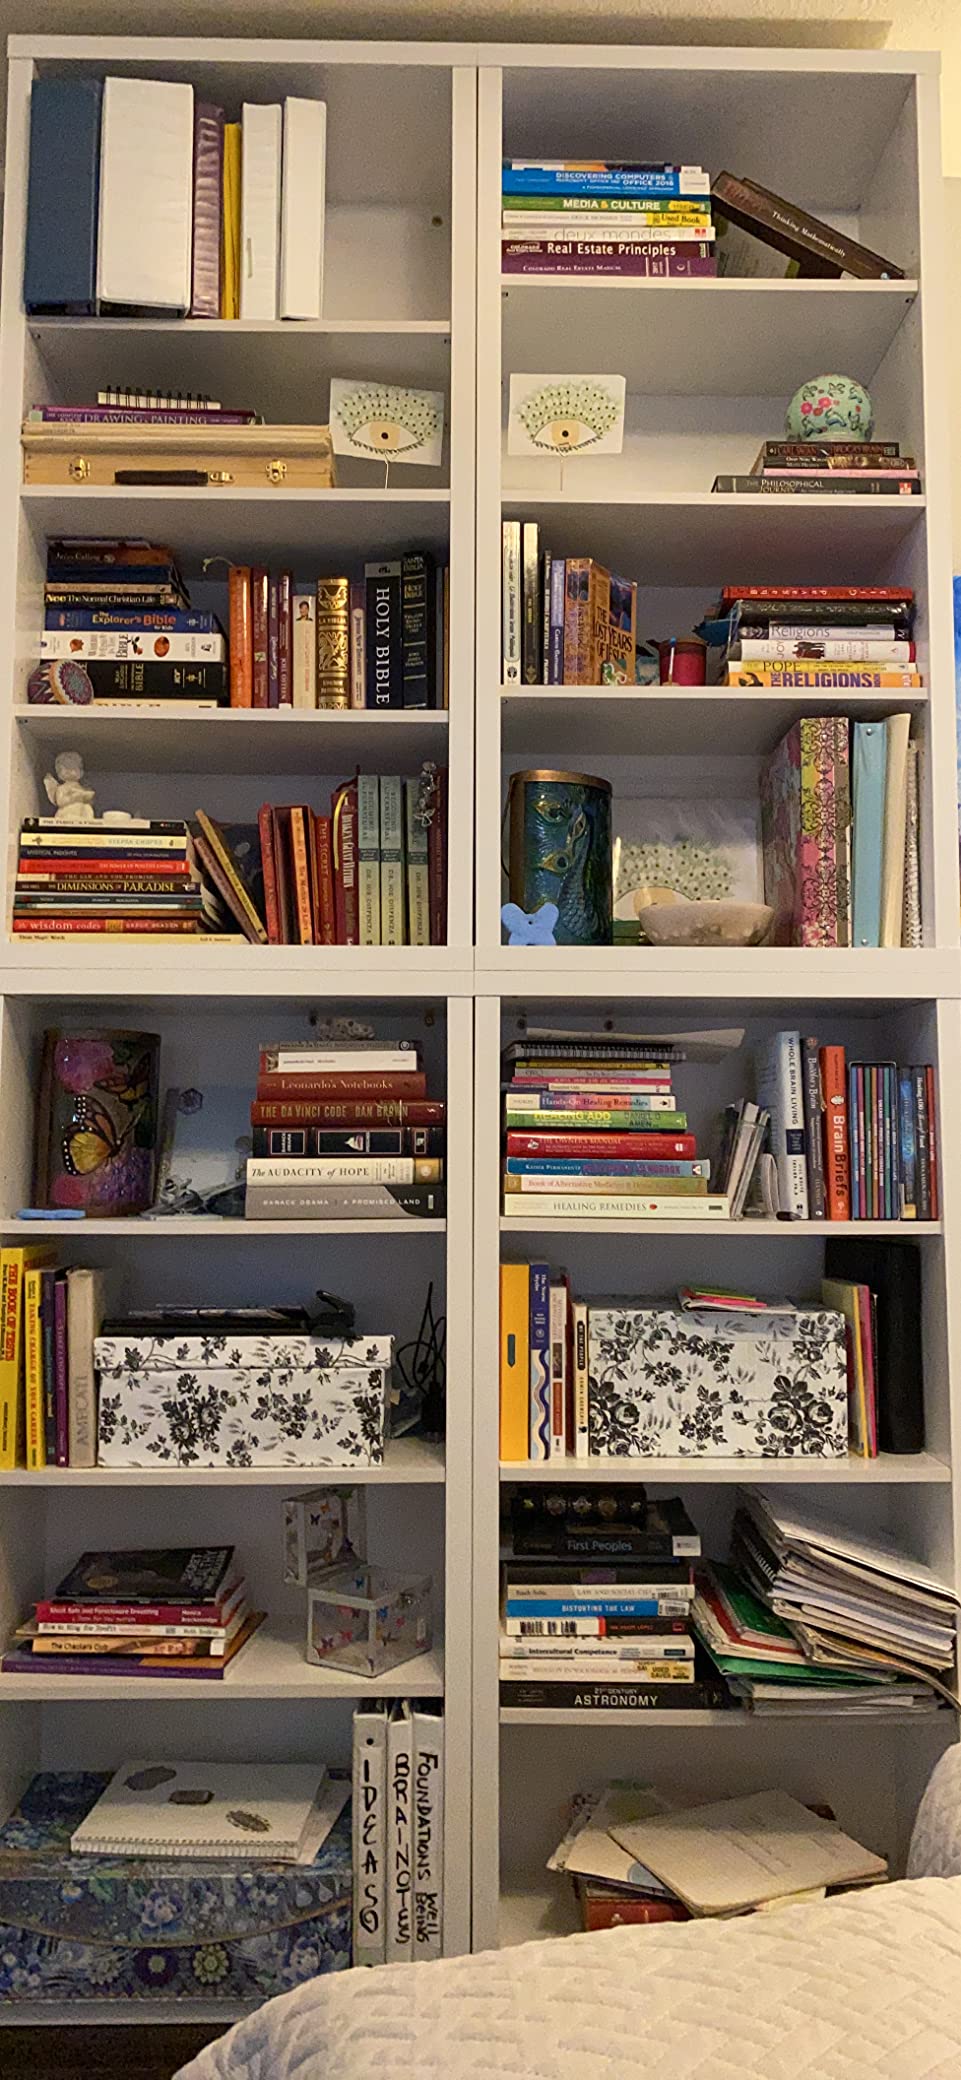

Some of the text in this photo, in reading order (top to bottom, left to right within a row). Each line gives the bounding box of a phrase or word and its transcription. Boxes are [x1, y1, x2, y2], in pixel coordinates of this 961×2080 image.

[563, 199, 598, 208] MEDIA
[611, 200, 660, 211] CULTURE
[661, 211, 700, 224] Used Book
[602, 228, 671, 240] mondes
[772, 211, 846, 257] Thinking Mathematically
[547, 242, 676, 257] Real Estate Principles
[84, 412, 145, 424] DRAWING
[151, 414, 208, 425] PAINTING
[761, 479, 823, 488] PHILOSOPHICAL
[67, 594, 81, 602] The
[82, 594, 108, 602] Normal
[108, 594, 141, 603] Christian
[92, 613, 176, 625] Explorer's Bible
[609, 625, 632, 653] YEARS
[771, 625, 830, 640] Religions
[376, 587, 390, 705] HOLY BIBLE
[776, 640, 785, 658] JOY
[763, 662, 801, 672] POPE
[135, 664, 144, 691] BIBLE
[783, 672, 873, 687] RELIGIONS
[319, 822, 329, 876] THE SECRET
[57, 881, 175, 892] DIMENSIONS PARADISE
[30, 920, 101, 930] wisdom codes
[787, 1037, 796, 1066] WHOLE
[281, 1079, 393, 1089] Leonardo's Notebooks
[789, 1069, 797, 1096] BRAIN
[542, 1096, 581, 1106] Hands-On
[583, 1097, 612, 1108] Healing
[809, 1088, 818, 1109] Brain
[260, 1105, 347, 1118] THE DA VINCI CODE
[355, 1104, 409, 1118] DAN BROWN
[586, 1112, 611, 1120] ADD
[252, 1167, 369, 1179] The AUDACITY of HOPE
[554, 1203, 647, 1211] HEALING REMEDIES
[8, 1263, 18, 1285] THE
[7, 1287, 18, 1313] BOOK
[6, 1315, 17, 1326] OF
[567, 1541, 632, 1553] First Peoples
[561, 1621, 577, 1634] LAW
[574, 1648, 617, 1656] Competence
[574, 1695, 658, 1705] ASTRONOMY
[416, 1752, 438, 1881] FOUNDATIONS
